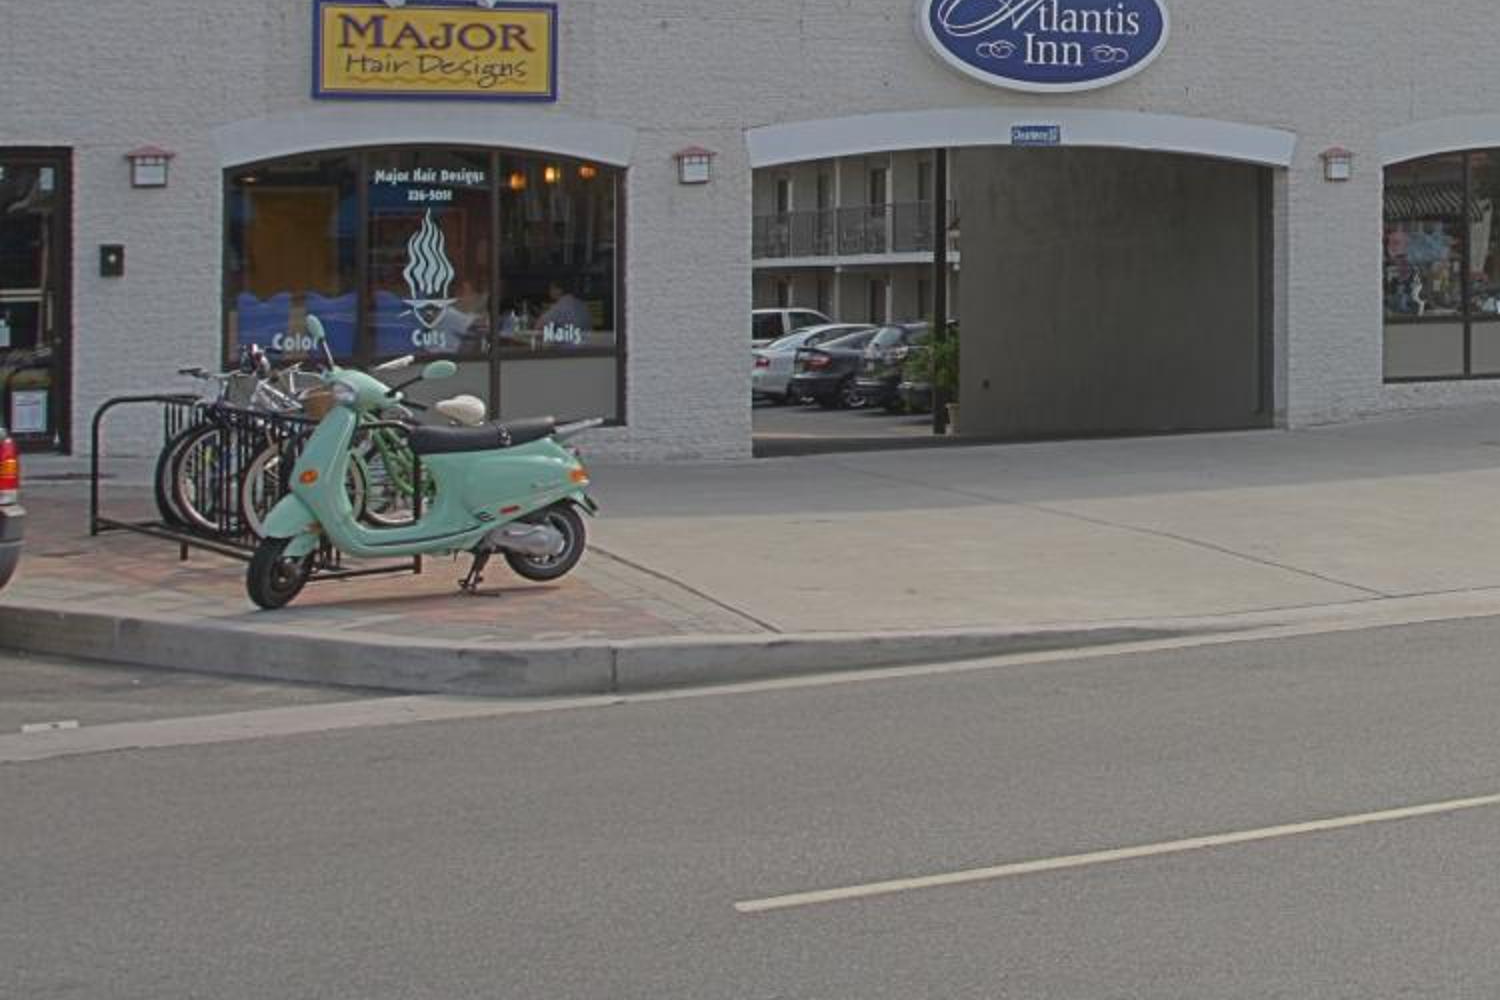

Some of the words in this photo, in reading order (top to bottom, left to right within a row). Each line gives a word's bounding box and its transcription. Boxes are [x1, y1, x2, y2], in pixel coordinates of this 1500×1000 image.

[337, 13, 535, 53] MAJOR
[1023, 32, 1083, 67] Inn
[345, 53, 411, 73] Hair
[417, 54, 529, 88] Designs
[374, 167, 409, 185] Major
[413, 167, 437, 182] Hair
[441, 167, 484, 185] Designs
[411, 329, 447, 347] Cuts
[543, 321, 582, 345] Nails
